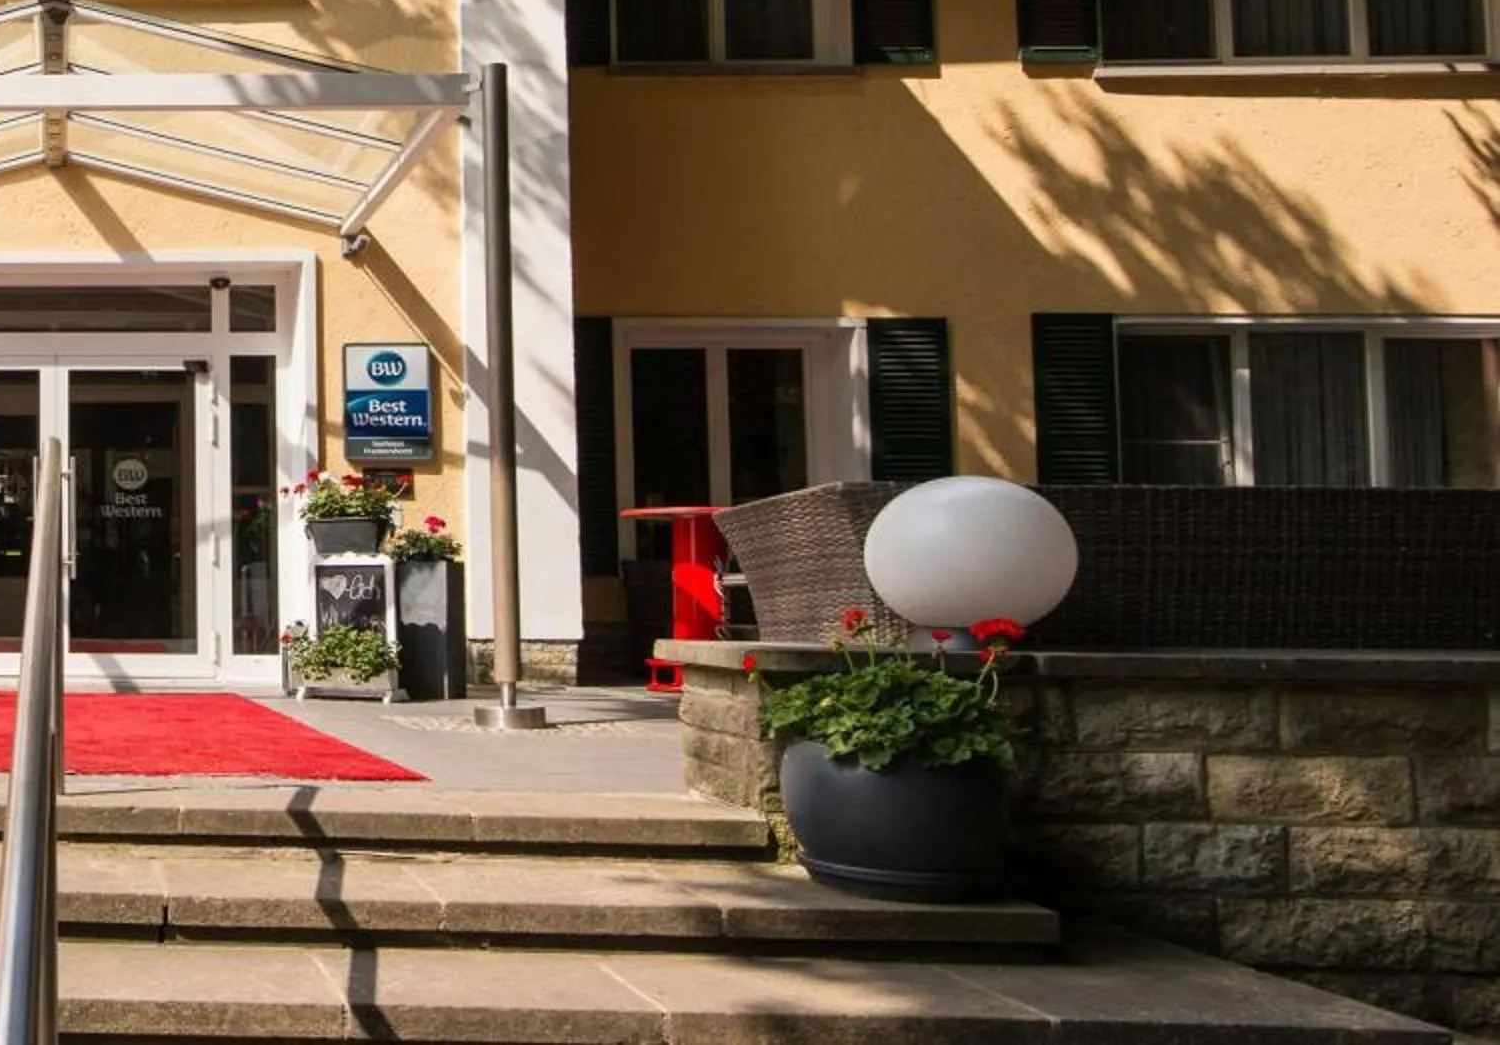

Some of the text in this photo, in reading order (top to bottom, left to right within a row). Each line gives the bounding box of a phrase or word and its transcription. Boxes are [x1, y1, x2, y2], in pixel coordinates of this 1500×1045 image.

[370, 360, 403, 376] BW
[368, 398, 407, 413] Best
[115, 491, 149, 504] Best
[101, 504, 162, 518] Western
